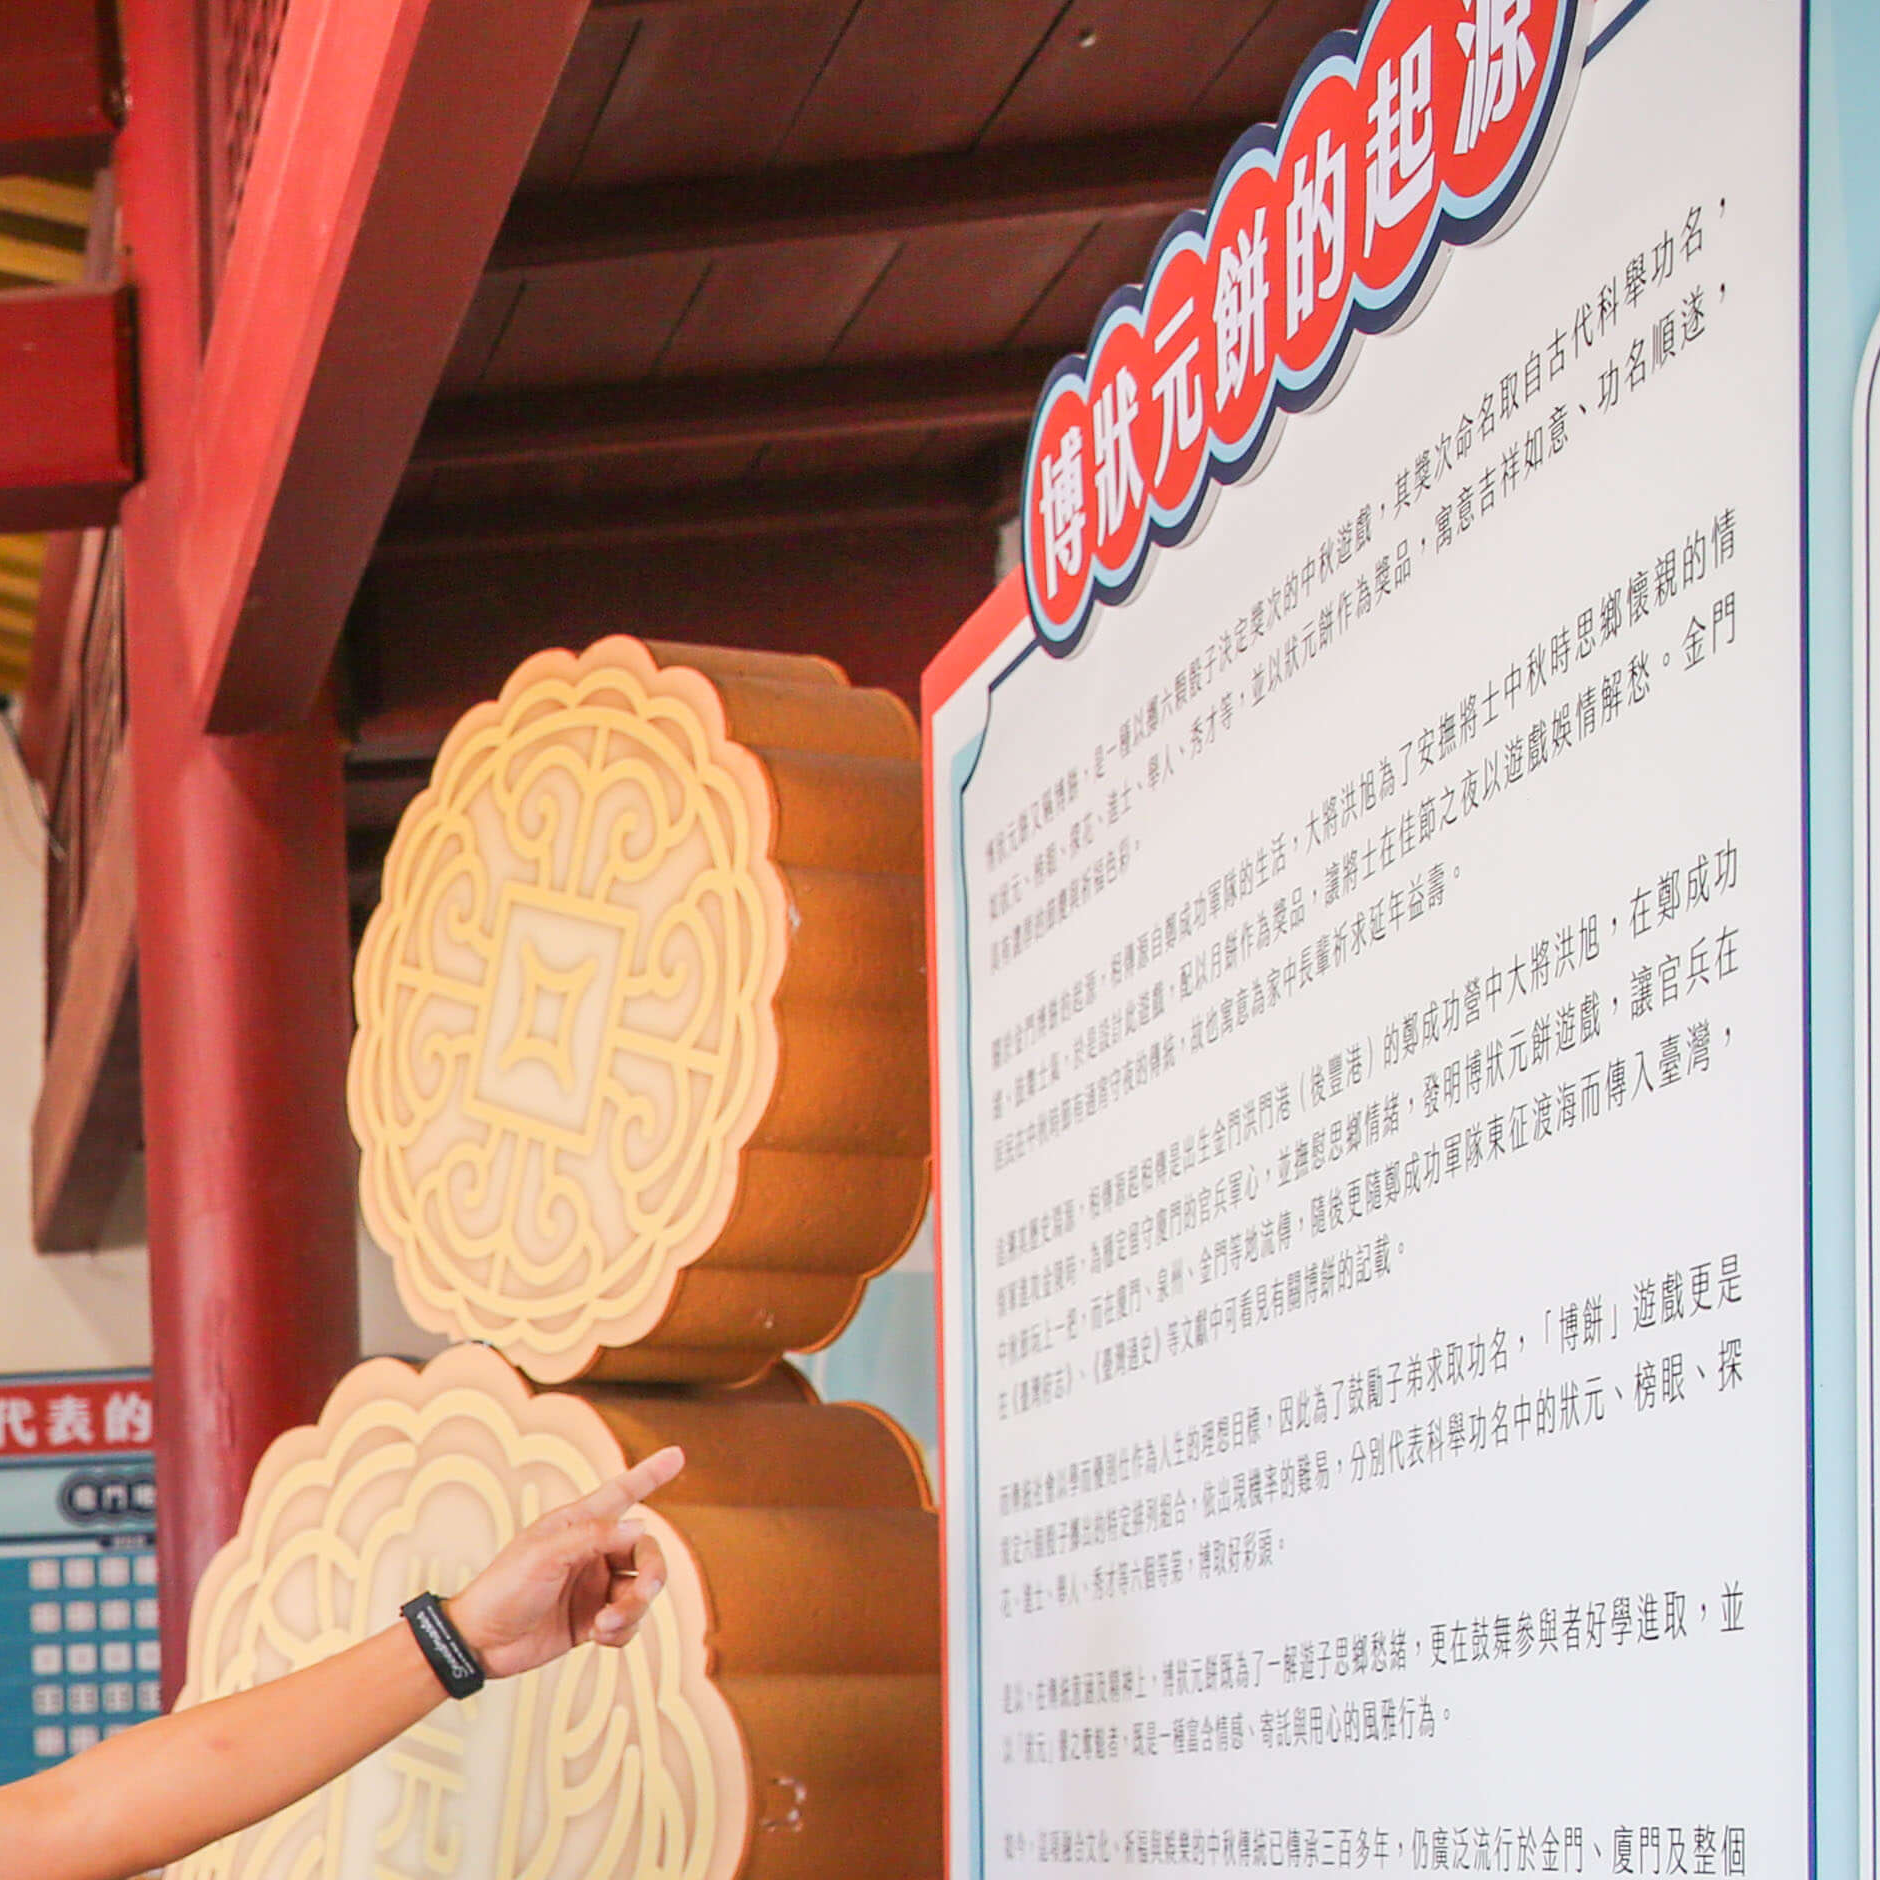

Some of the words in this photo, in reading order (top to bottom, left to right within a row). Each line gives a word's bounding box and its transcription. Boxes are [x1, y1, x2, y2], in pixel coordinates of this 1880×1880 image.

[1039, 0, 1537, 600] 博狀元餅的起源
